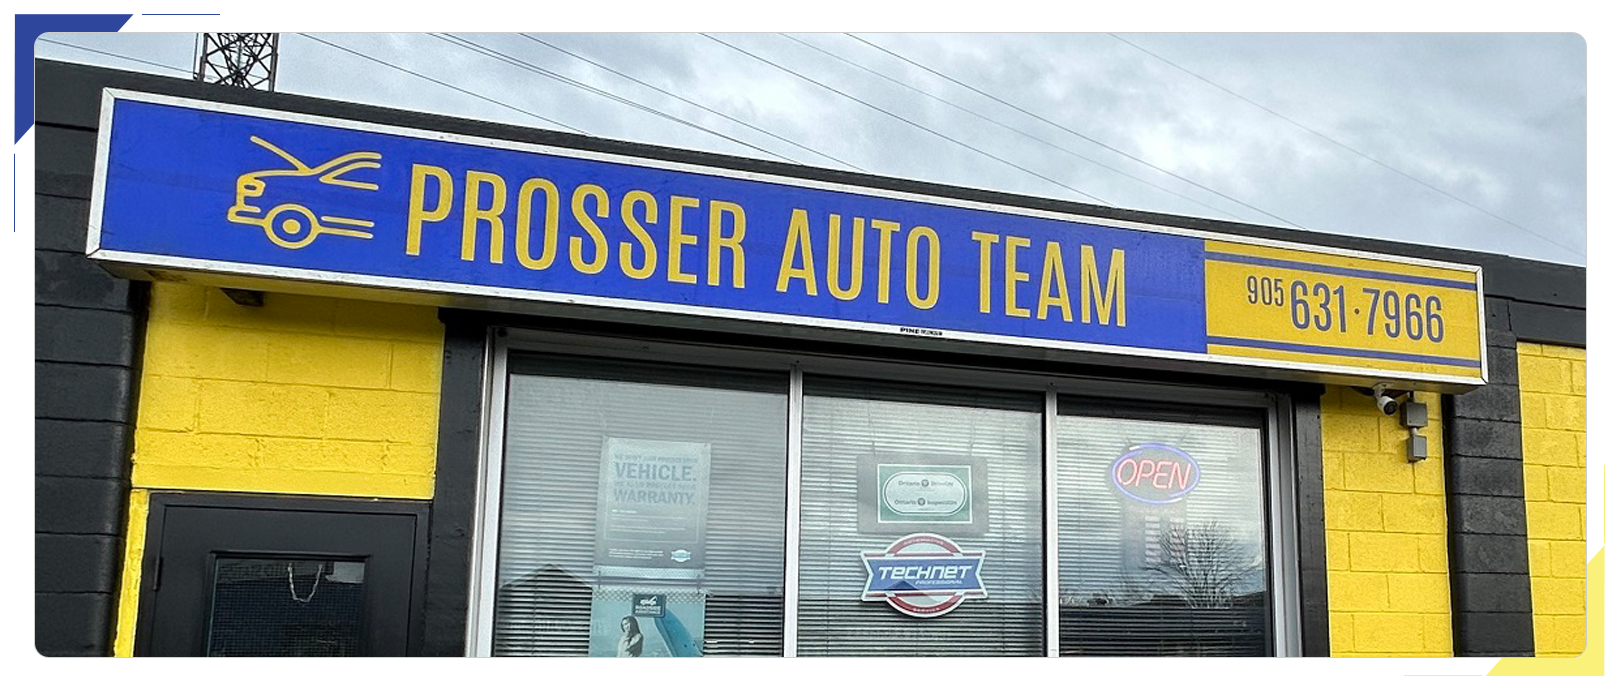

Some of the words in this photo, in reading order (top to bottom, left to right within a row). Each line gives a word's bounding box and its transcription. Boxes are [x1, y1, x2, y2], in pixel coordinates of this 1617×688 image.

[405, 163, 747, 289] PROSSER
[775, 208, 942, 310] AUTO
[971, 230, 1127, 328] TEAM
[1246, 275, 1285, 307] 905
[614, 462, 697, 482] VEHICLE.
[1116, 457, 1192, 491] OPEN
[613, 488, 696, 505] WARRANTY.
